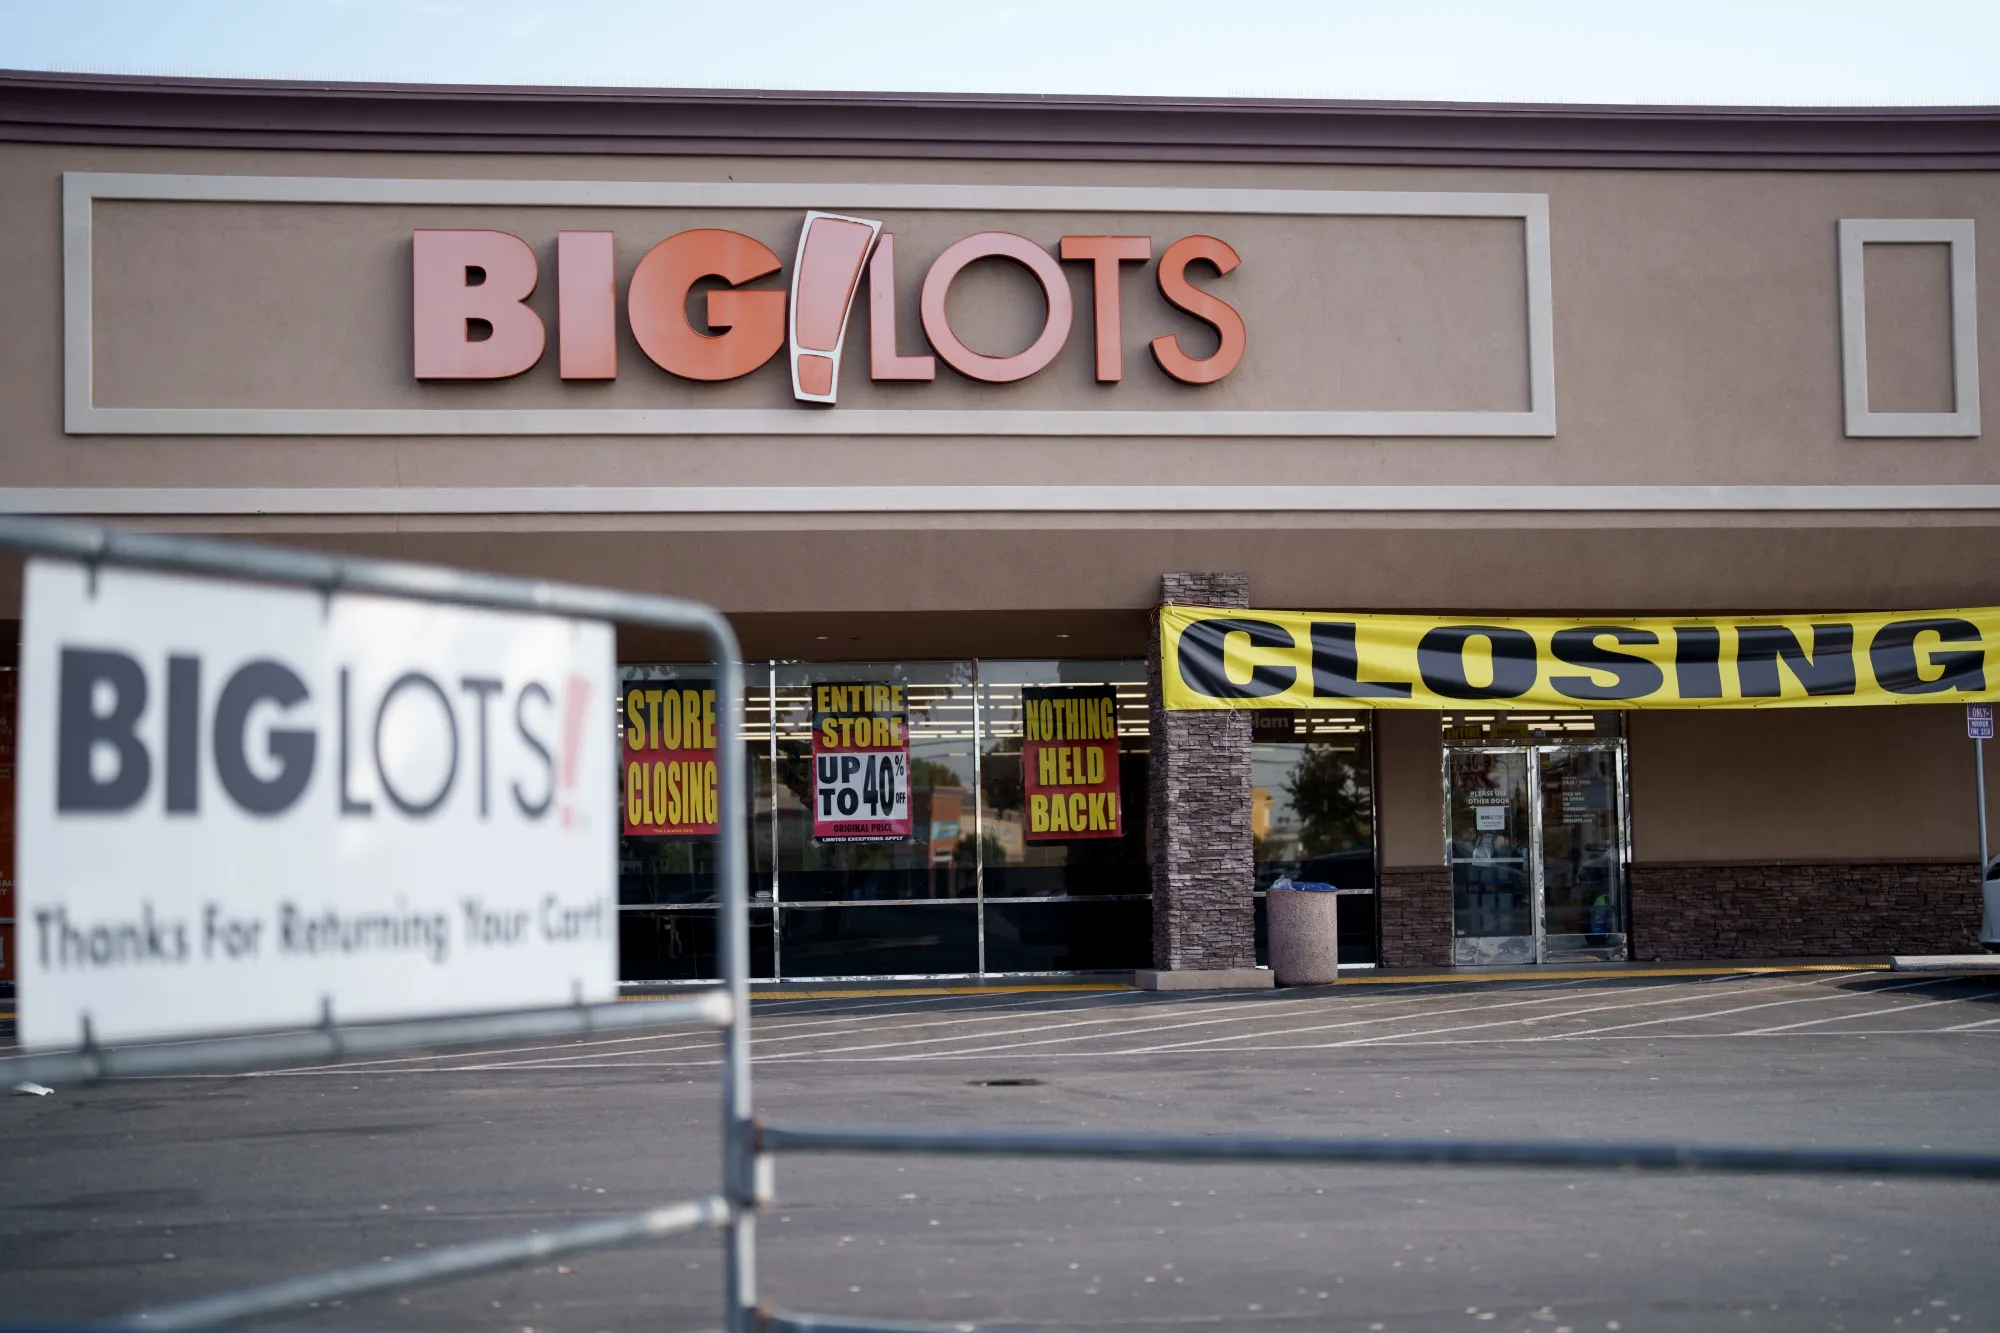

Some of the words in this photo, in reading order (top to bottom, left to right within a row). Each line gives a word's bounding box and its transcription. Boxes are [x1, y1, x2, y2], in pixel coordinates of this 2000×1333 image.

[1177, 617, 1986, 698] CLOSING
[817, 685, 904, 713] ENTIRE
[628, 689, 717, 750] STORE
[821, 717, 904, 747] STORE
[1025, 697, 1115, 741] NOTHING
[818, 756, 861, 784] UP
[1038, 747, 1105, 786] HELD
[628, 761, 718, 825] CLOSING
[818, 787, 859, 816] TO
[895, 791, 906, 804] OFF
[1030, 792, 1117, 832] BACK!
[833, 824, 869, 833] ORIGINAL
[871, 823, 892, 832] PRICE
[33, 905, 191, 969] Thanks
[203, 903, 262, 959] For
[279, 900, 450, 964] Returning
[461, 899, 530, 945] Your
